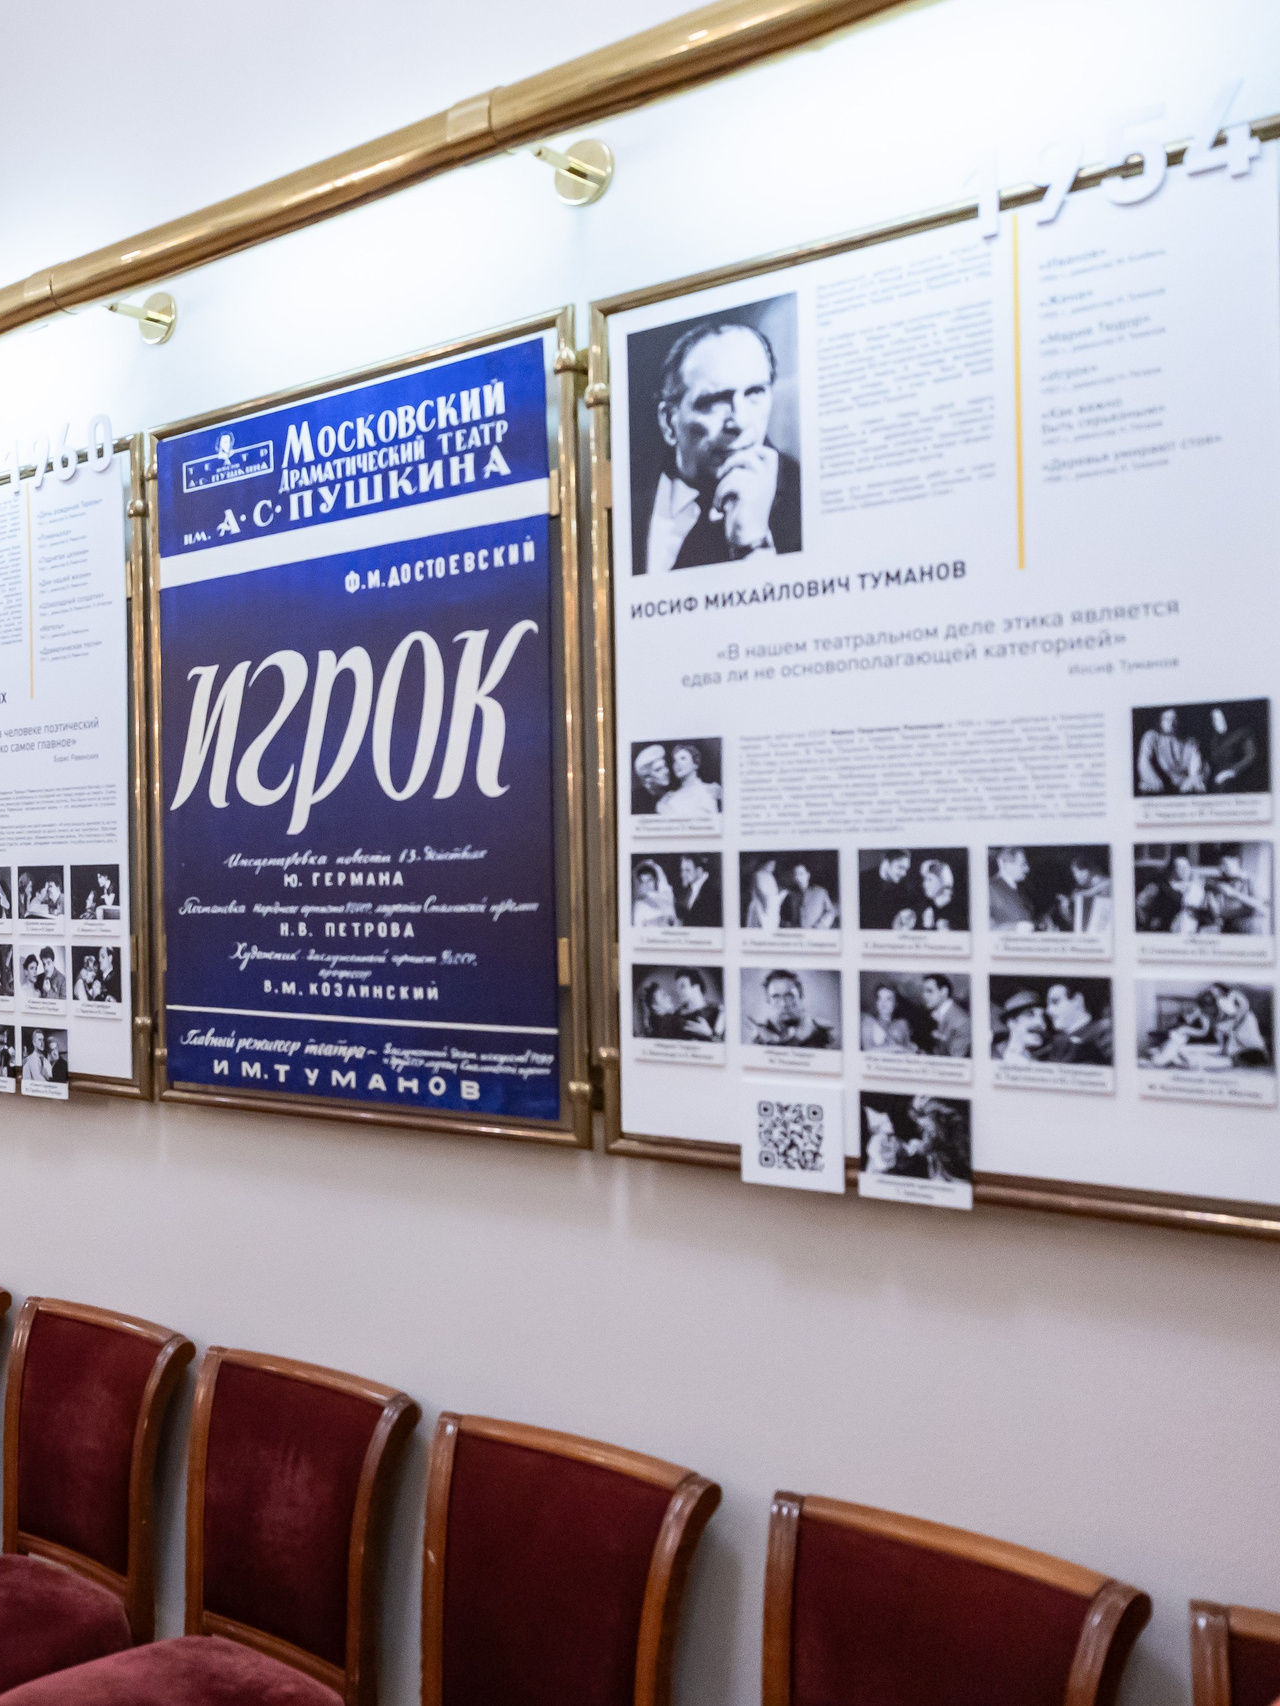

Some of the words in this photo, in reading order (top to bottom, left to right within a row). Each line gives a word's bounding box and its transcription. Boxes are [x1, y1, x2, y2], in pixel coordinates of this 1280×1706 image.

[960, 78, 1262, 240] 1954
[4, 413, 114, 494] 1960
[278, 434, 426, 494] ДРАМАТИЧЕСКИЙ
[437, 419, 509, 455] ТЕАТР
[289, 444, 512, 521] ПУШКИНА
[631, 596, 699, 619] ИОСИФ
[704, 577, 851, 611] МИХАЙЛОВИЧ
[857, 560, 966, 592] ТУМАНОВ
[745, 639, 808, 659] нашем
[813, 624, 939, 652] театральном
[943, 619, 996, 641] деле
[1001, 611, 1065, 633] этика
[1070, 599, 1180, 626] является
[681, 672, 722, 688] едва
[727, 670, 750, 683] ли
[754, 667, 776, 681] не
[781, 643, 978, 679] основополагающей
[4, 725, 42, 738] человеке
[43, 716, 100, 734] поэтический
[10, 741, 36, 753] самое
[283, 873, 303, 888] Ю.
[312, 870, 404, 887] ГЕРМАНА
[324, 921, 415, 938] ПЕТРОВА
[309, 980, 439, 1001] КОЗЛИНСКИЙ
[180, 1027, 236, 1049] Главный
[274, 1064, 481, 1101] ТУМАНОВ
